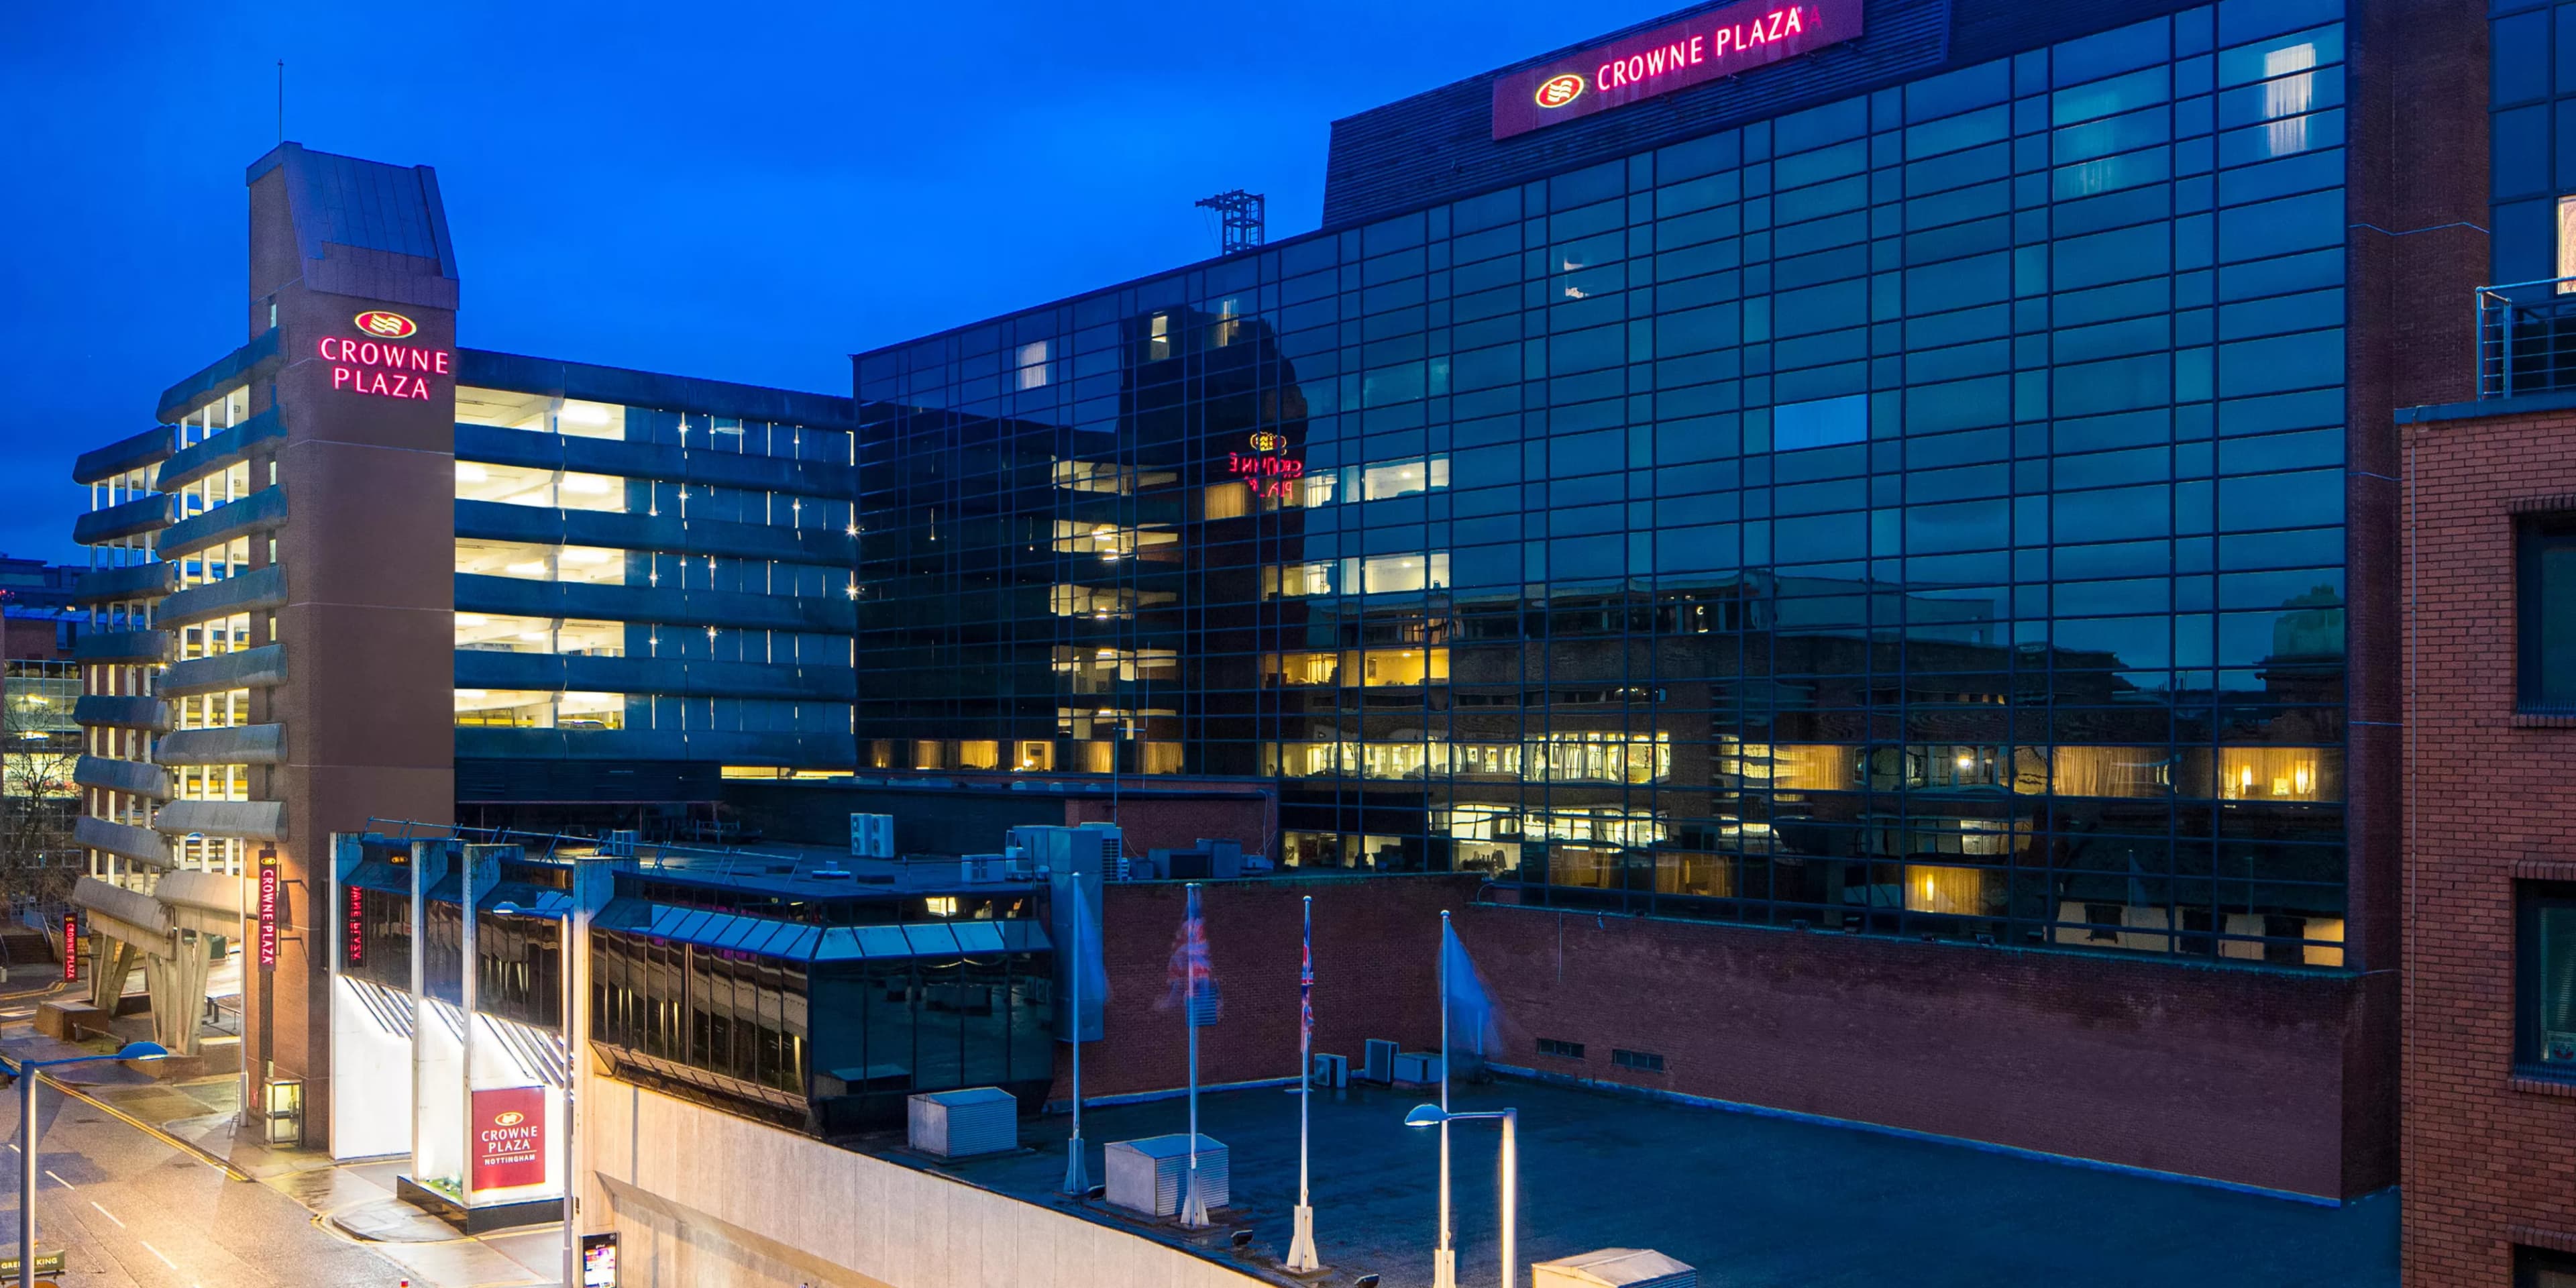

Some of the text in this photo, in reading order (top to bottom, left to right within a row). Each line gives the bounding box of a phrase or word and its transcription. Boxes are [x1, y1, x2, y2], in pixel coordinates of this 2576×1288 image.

[1597, 7, 1802, 91] CROWNE PLAZA
[320, 337, 449, 374] CROWNE
[333, 367, 429, 400] PLAZA
[262, 869, 274, 964] CROWNE PLAZA
[67, 955, 75, 978] PLAZA
[481, 1126, 538, 1142] CROWNE
[488, 1138, 531, 1153] PLAZA
[484, 1153, 535, 1166] NOTTINGHAM
[36, 1257, 58, 1265] KING
